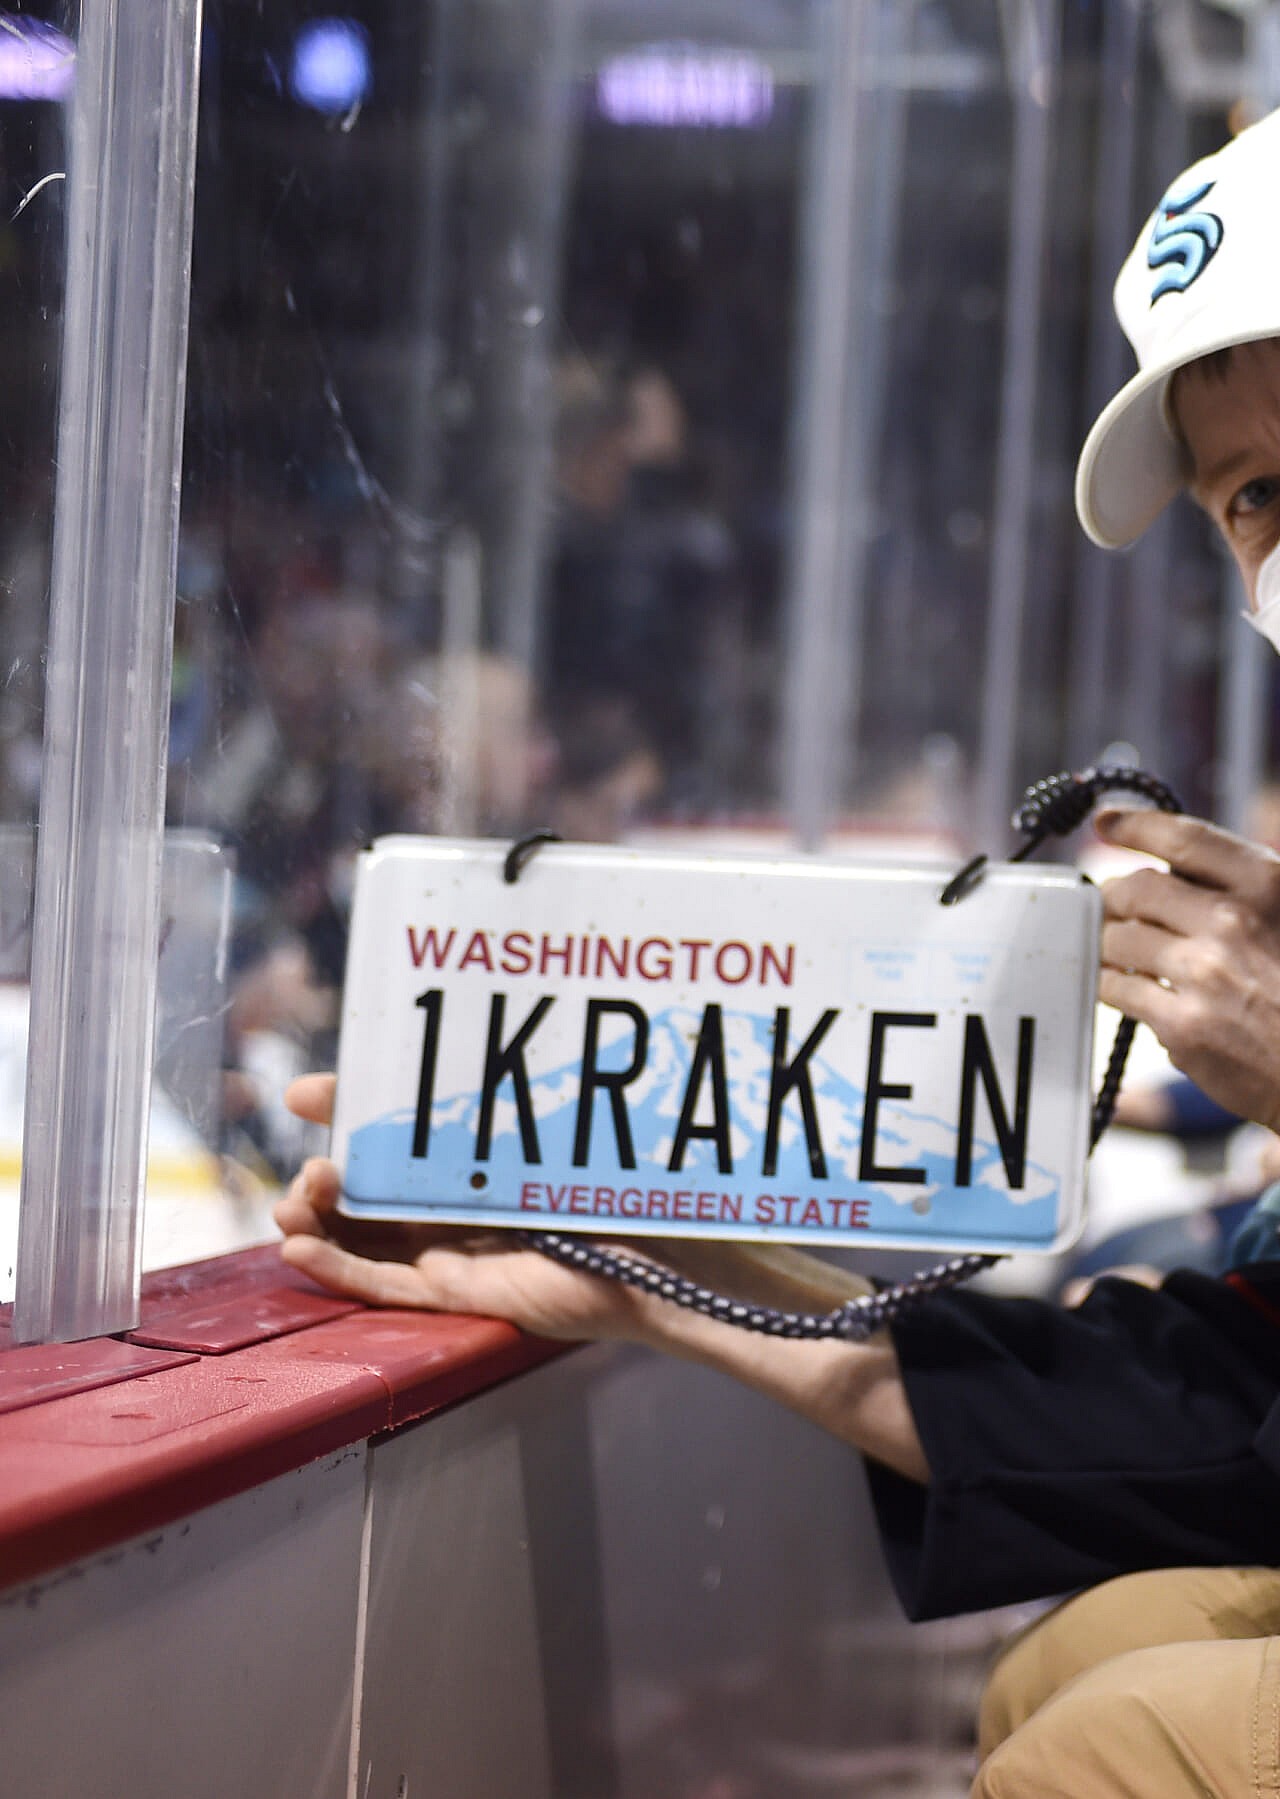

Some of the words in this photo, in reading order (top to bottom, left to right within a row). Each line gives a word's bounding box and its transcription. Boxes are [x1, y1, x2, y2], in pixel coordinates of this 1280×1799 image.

[408, 927, 795, 987] WASHINGTON
[411, 989, 1036, 1190] 1KRAKEN
[519, 1182, 742, 1222] EVERGREEN
[754, 1195, 872, 1229] STATE
